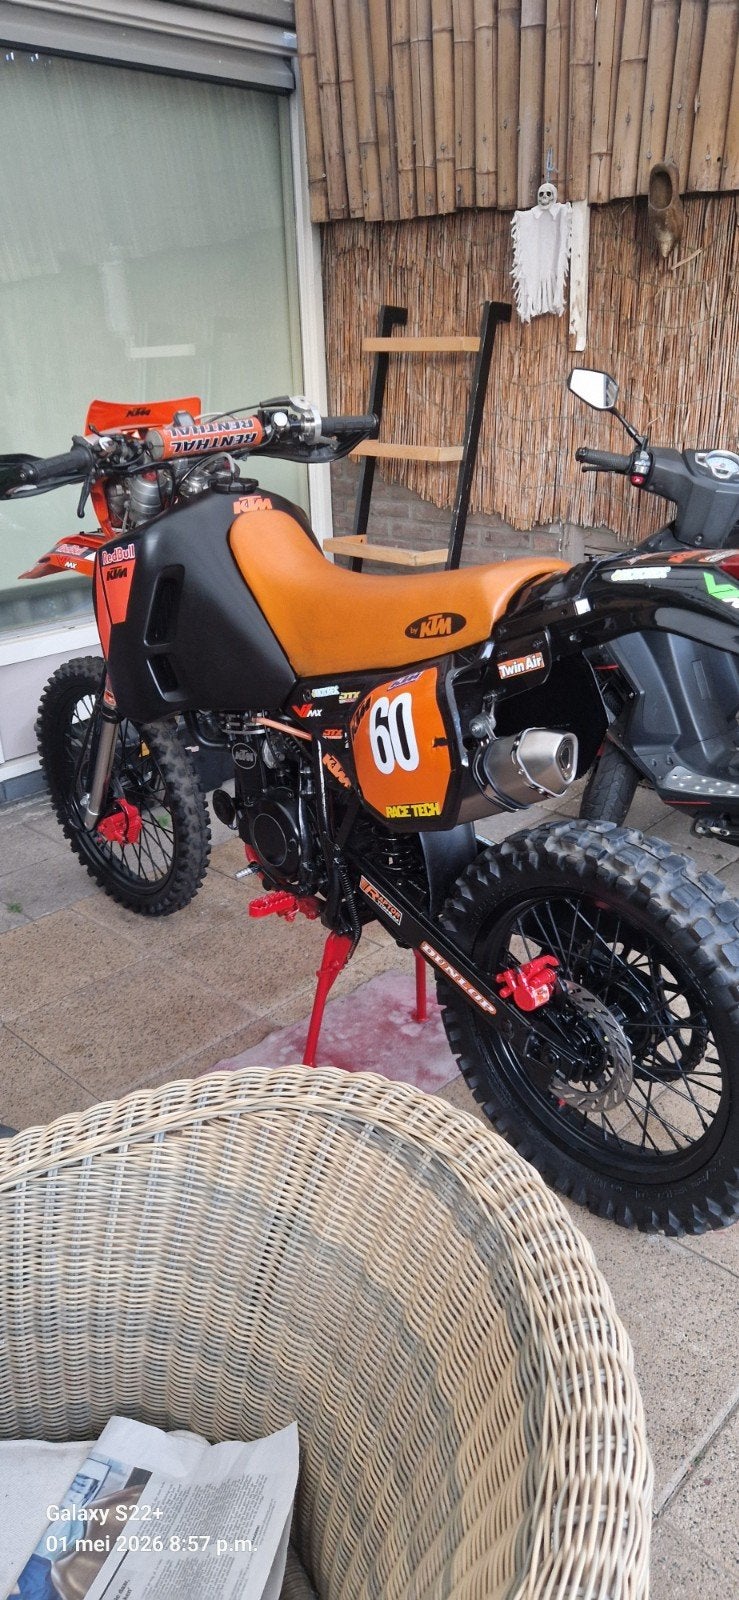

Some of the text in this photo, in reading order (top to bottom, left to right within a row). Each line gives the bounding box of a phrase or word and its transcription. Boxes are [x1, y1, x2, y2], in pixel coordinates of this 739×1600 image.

[127, 406, 151, 417] KTM
[170, 420, 254, 436] RENTHAL
[171, 433, 257, 452] RENTHAL
[233, 495, 273, 514] KTM
[107, 566, 127, 581] KTM
[410, 614, 451, 638] by KTM
[498, 655, 543, 677] Twin Air
[369, 693, 419, 774] 60
[322, 753, 351, 788] KTM
[386, 802, 439, 818] RACE TECH
[423, 944, 496, 1014] DUNLOP
